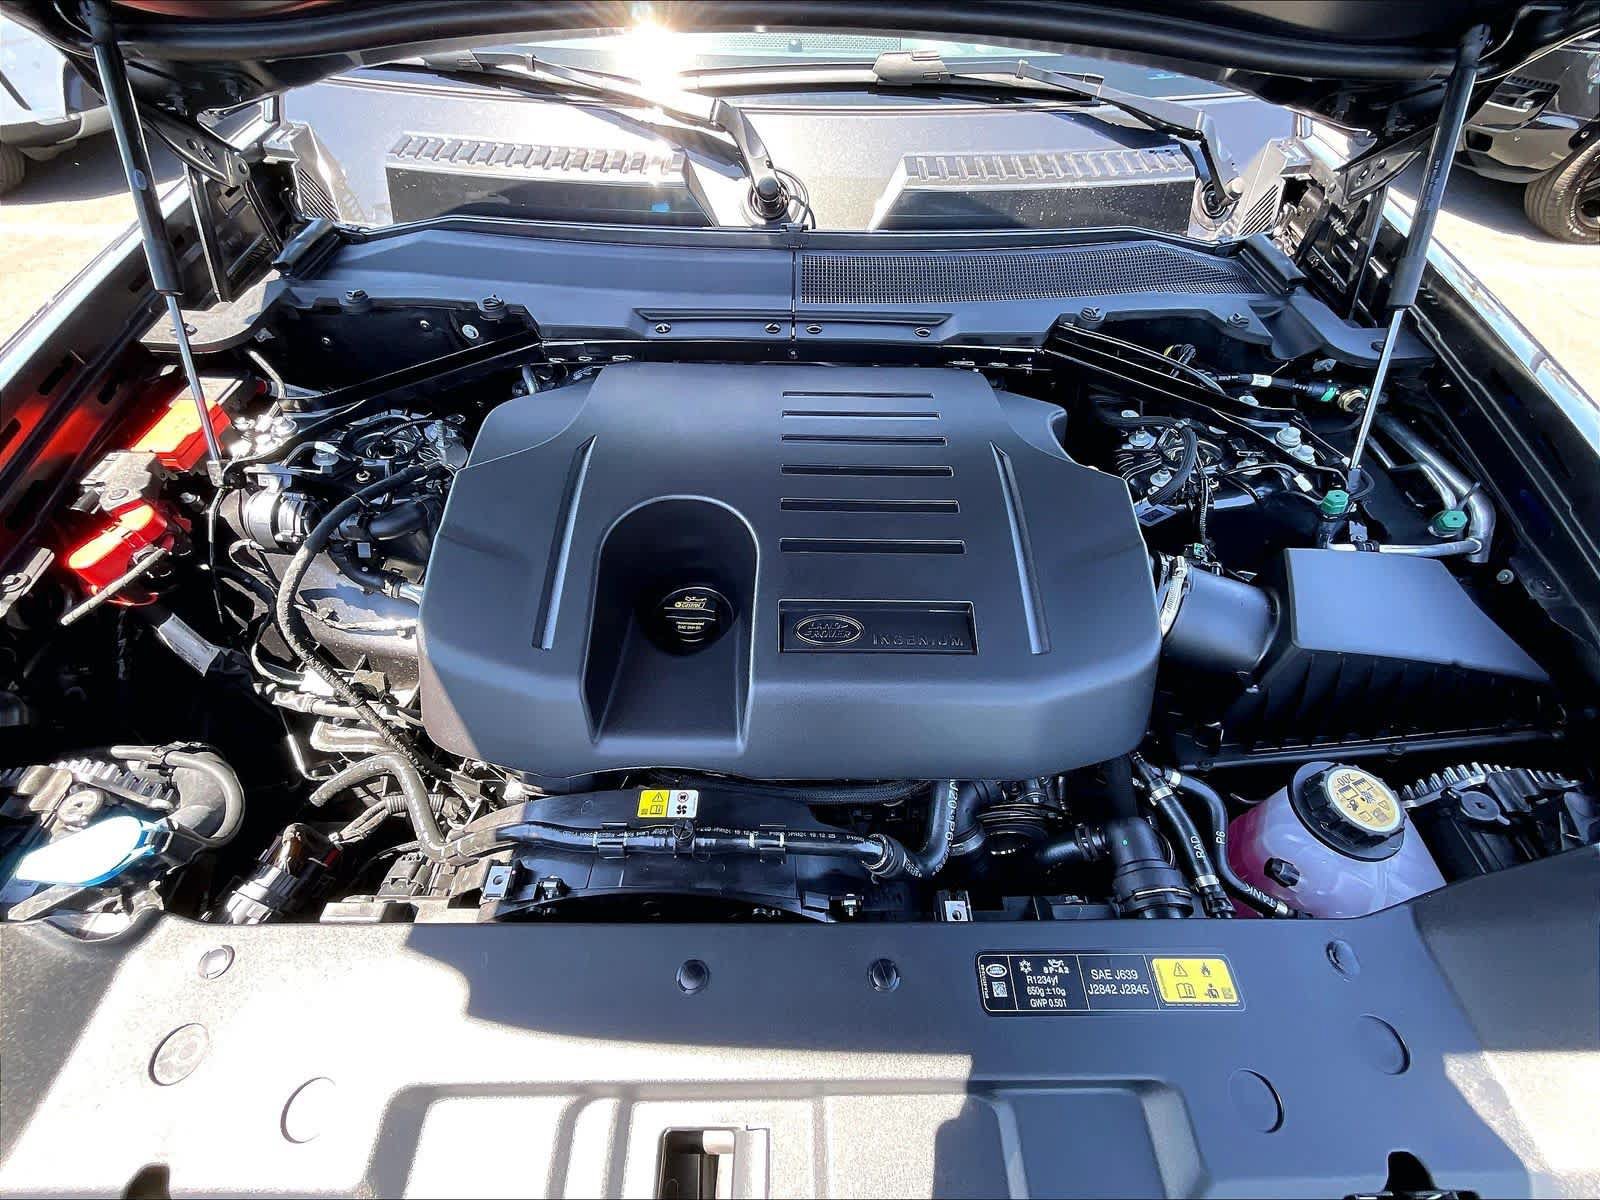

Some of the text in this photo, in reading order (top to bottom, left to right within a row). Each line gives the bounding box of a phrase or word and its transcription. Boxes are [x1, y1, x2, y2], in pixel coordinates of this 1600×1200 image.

[1190, 835, 1206, 859] RAD
[1215, 830, 1277, 908] TANK P6
[1090, 969, 1139, 980] SAE J639
[1026, 975, 1059, 986] R1234yf
[1026, 986, 1045, 997] 650g
[1088, 983, 1150, 995] J2842 J2845
[1030, 998, 1067, 1008] GWP 0.501
